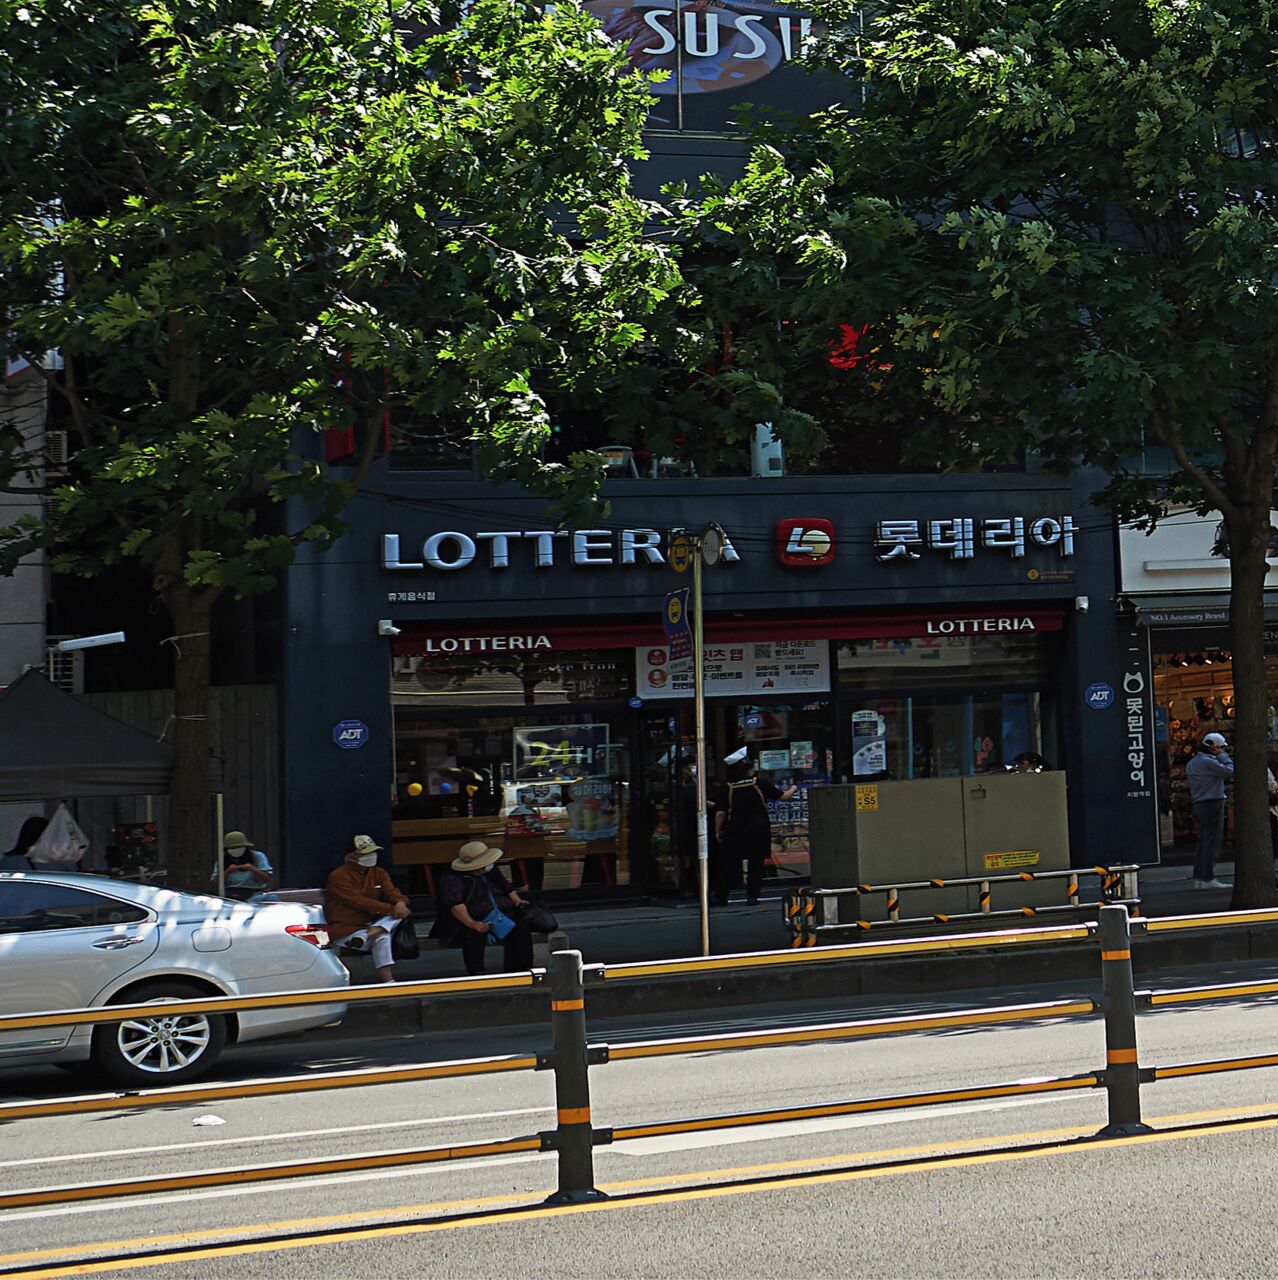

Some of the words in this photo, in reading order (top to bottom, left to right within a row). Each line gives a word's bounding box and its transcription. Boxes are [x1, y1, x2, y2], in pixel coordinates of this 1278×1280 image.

[380, 526, 740, 572] LOTTERA
[875, 517, 1078, 561] 롯데리아
[387, 591, 436, 602] 휴게음식점
[925, 616, 1036, 634] LOTTERIA
[425, 633, 553, 654] LOTTERIA
[1089, 689, 1111, 702] ADT
[338, 728, 363, 741] ADT
[1126, 696, 1146, 787] 못된고양이
[863, 795, 877, 806] S5
